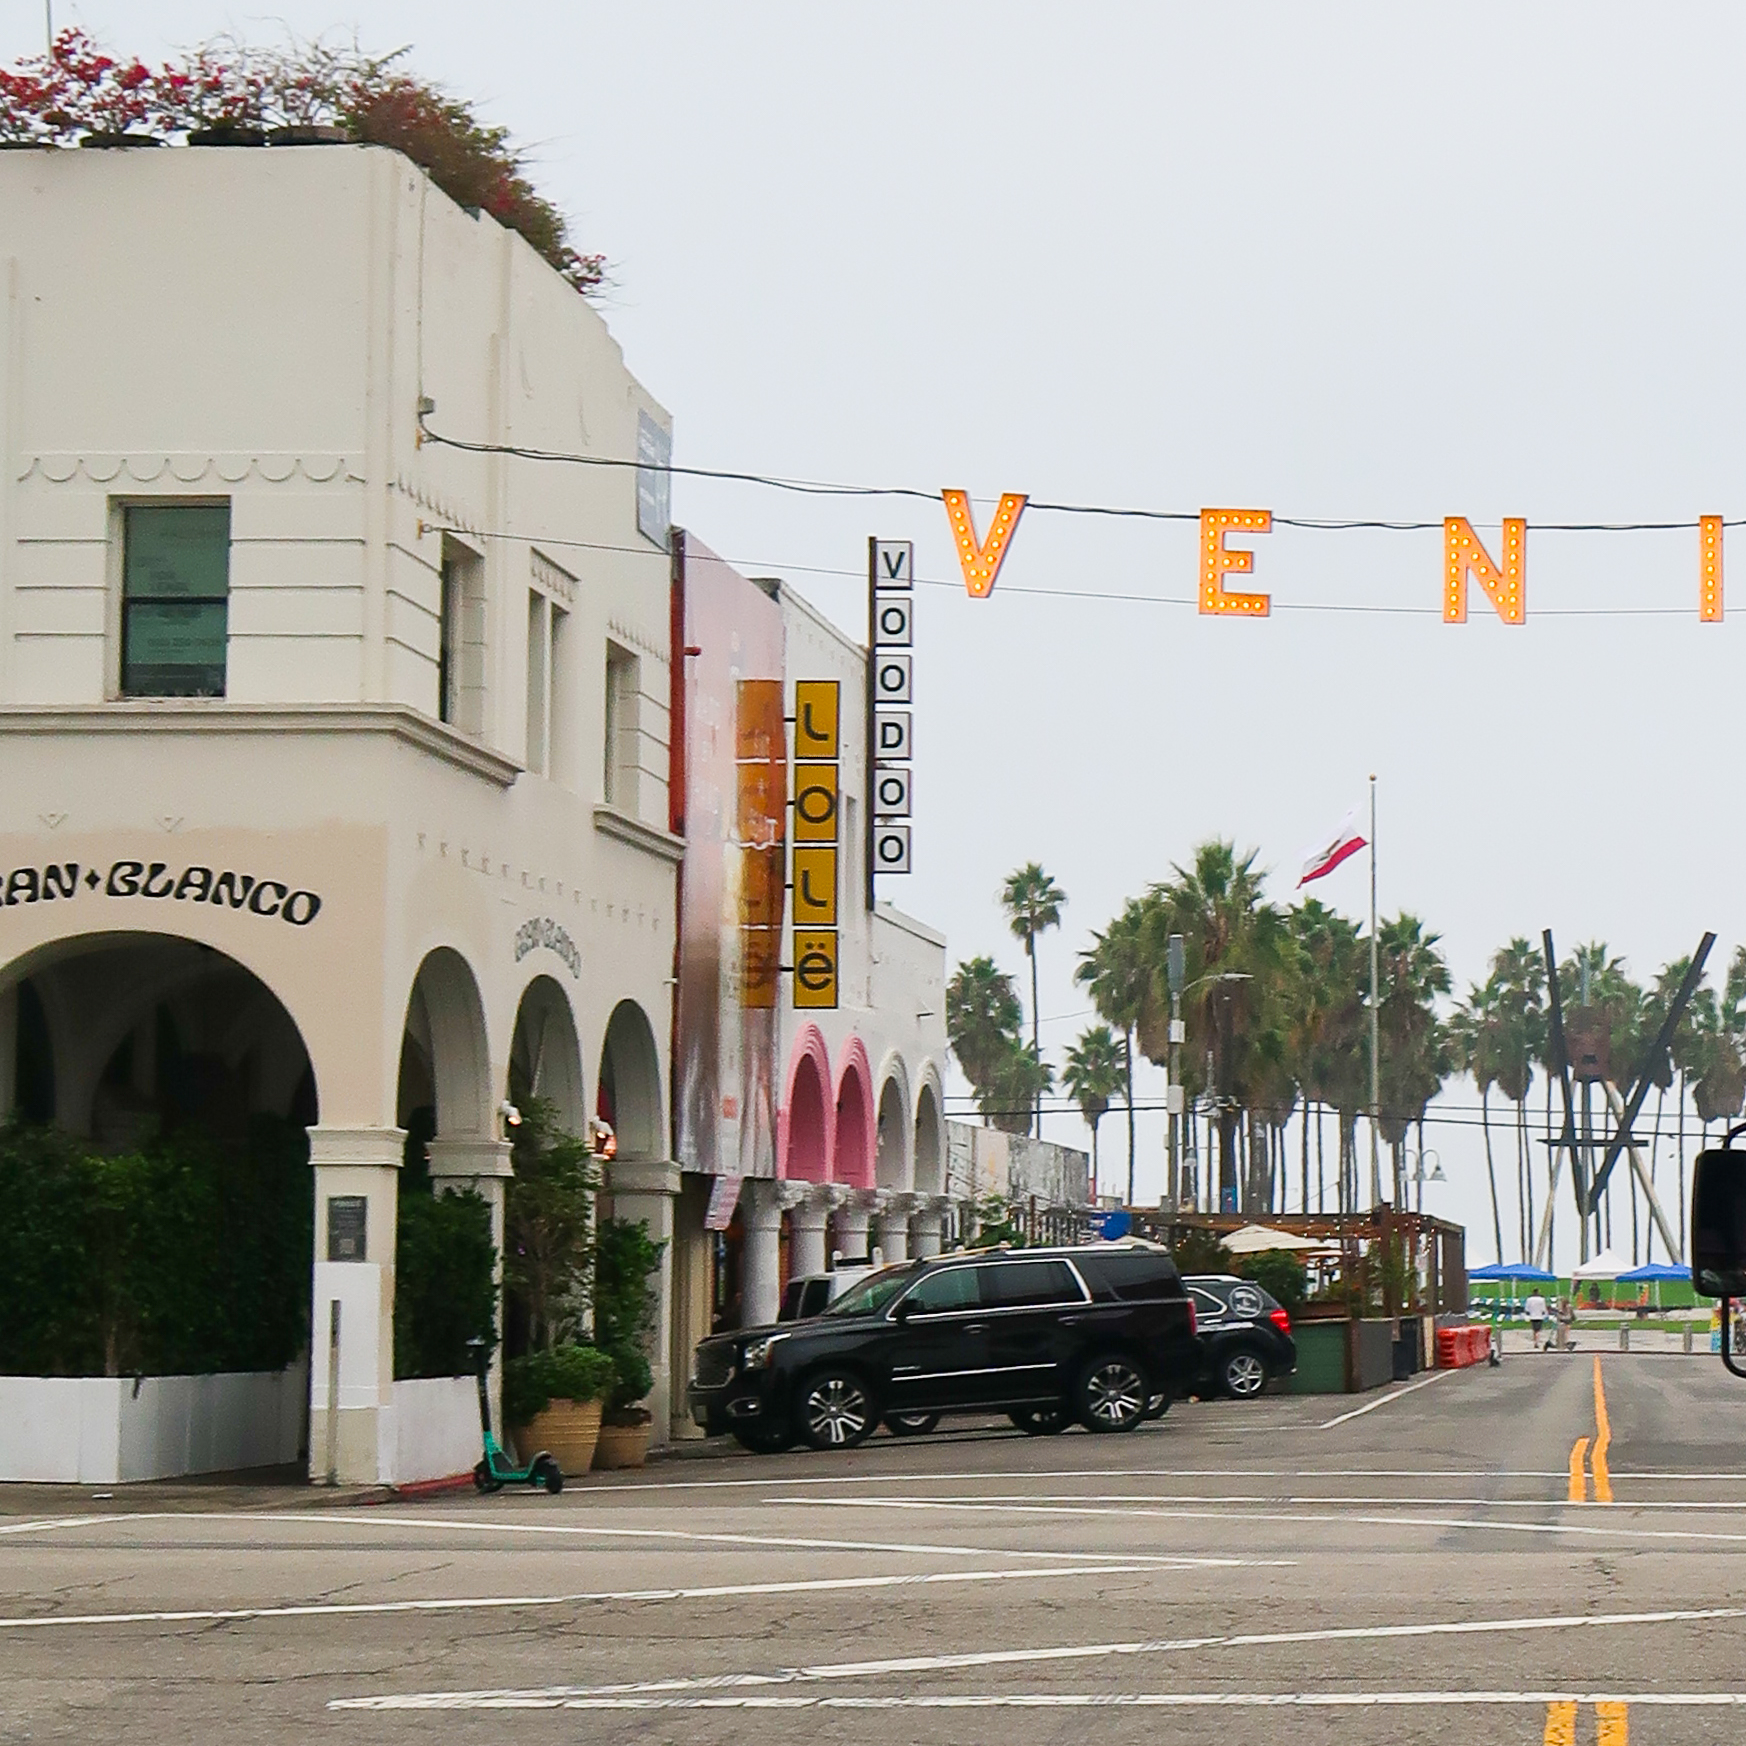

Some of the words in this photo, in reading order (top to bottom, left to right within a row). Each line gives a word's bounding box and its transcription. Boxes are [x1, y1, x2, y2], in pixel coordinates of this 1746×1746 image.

[880, 551, 906, 864] VOODOO
[0, 863, 79, 908] AN
[105, 861, 322, 926] BLANCO
